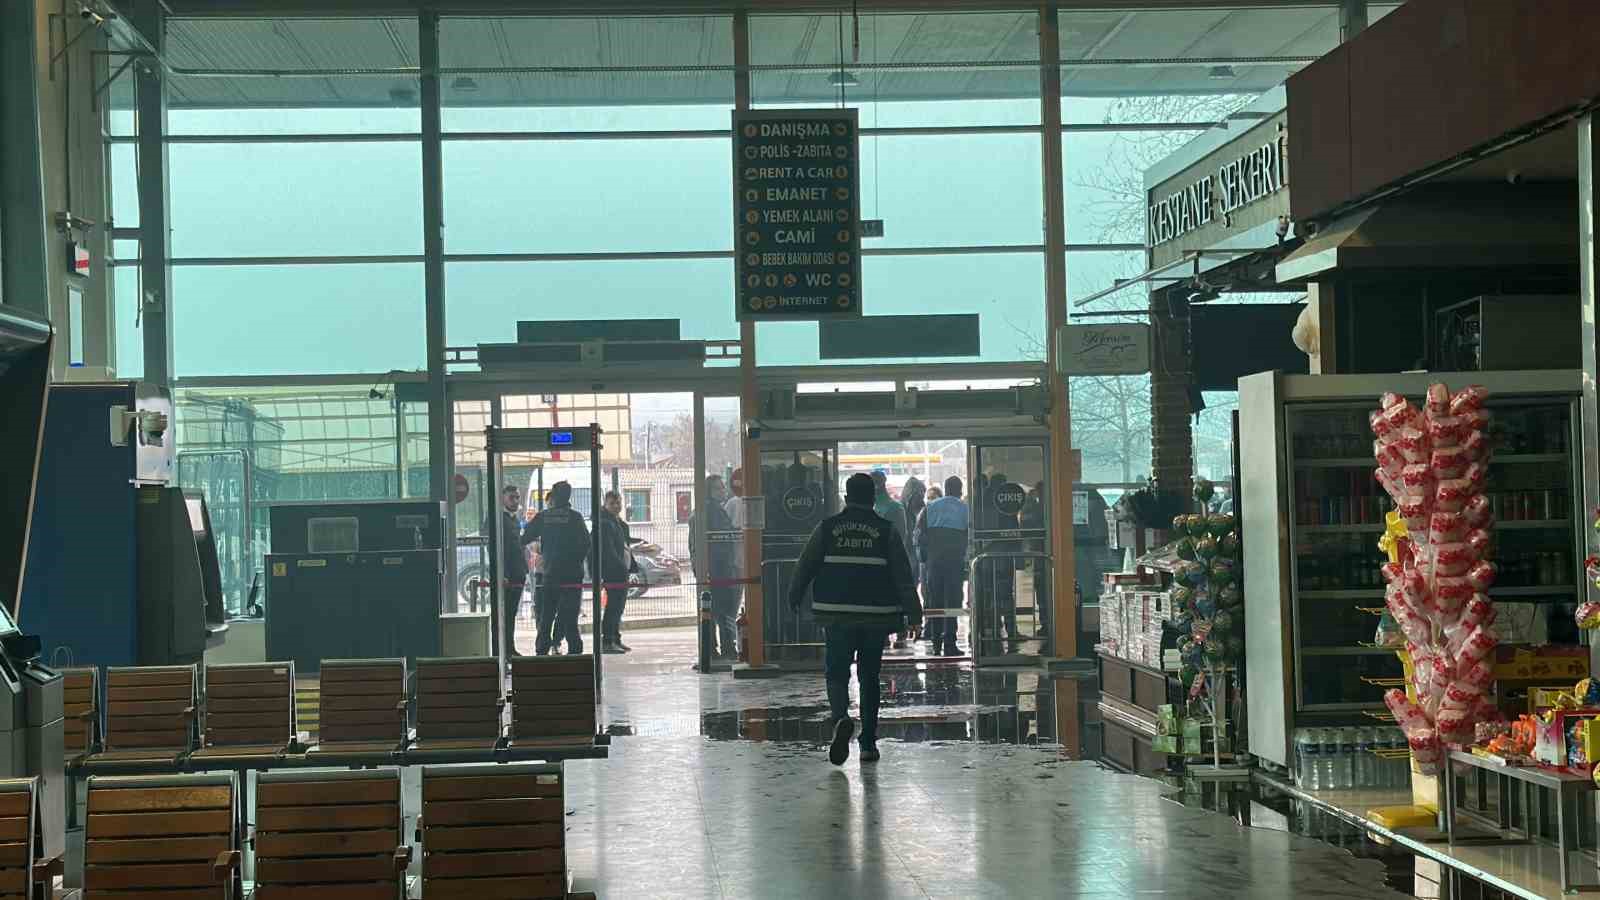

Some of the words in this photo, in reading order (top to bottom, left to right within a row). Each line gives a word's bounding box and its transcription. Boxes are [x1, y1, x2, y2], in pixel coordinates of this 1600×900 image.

[761, 123, 830, 139] DANIŞMA
[760, 144, 790, 159] POLİS
[759, 167, 793, 179] RENT
[794, 167, 805, 179] A
[807, 167, 833, 179] CAR
[1148, 175, 1212, 247] KESTANE
[1218, 121, 1284, 229] ŞEKERİ
[766, 187, 829, 201] EMANET
[762, 210, 800, 224] YEMEK
[801, 209, 834, 223] ALANI
[775, 227, 816, 244] CAMİ
[762, 253, 787, 266] BEBEK
[787, 253, 812, 266] BAKIM
[805, 273, 832, 287] WC
[997, 492, 1024, 504] ÇIKIŞ
[836, 537, 873, 549] ZABITA
